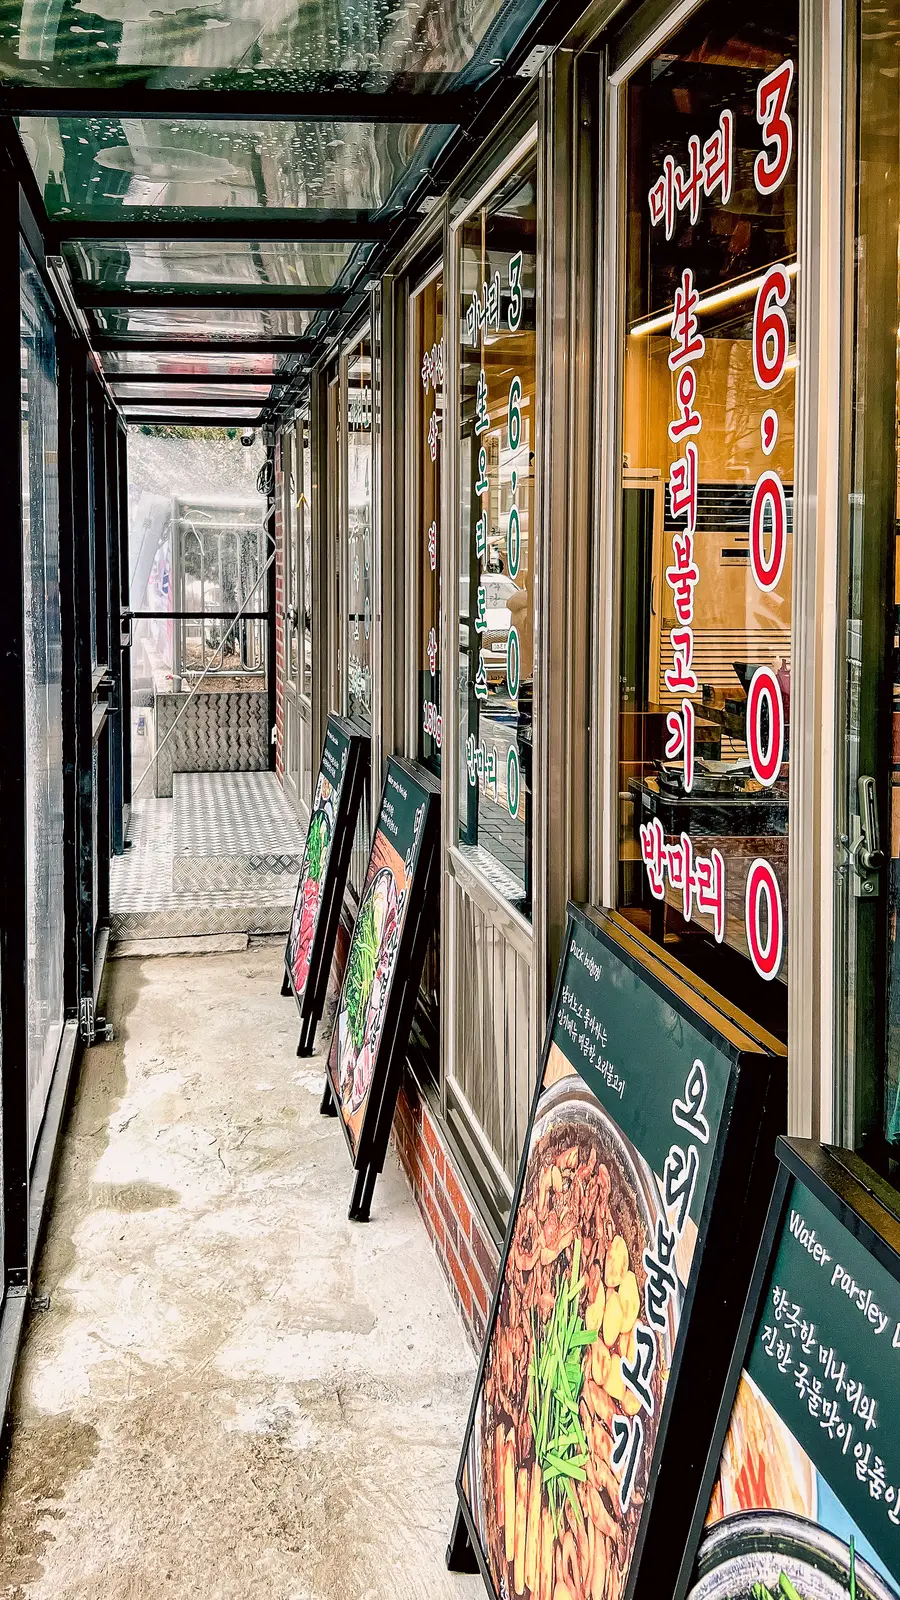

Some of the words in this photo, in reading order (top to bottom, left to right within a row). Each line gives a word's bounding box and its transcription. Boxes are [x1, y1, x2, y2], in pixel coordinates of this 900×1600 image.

[648, 109, 733, 240] 미나리
[466, 270, 500, 348] 미나리
[743, 59, 794, 981] 36,000
[423, 699, 443, 748] 150g
[466, 733, 497, 803] 반마리
[639, 816, 725, 943] 반마리
[570, 939, 584, 964] Duck
[562, 985, 583, 1019] 남녀노소
[558, 1008, 578, 1042] 인기메뉴
[595, 1056, 626, 1099] 오리불고기
[610, 1058, 709, 1513] 오리불고기
[789, 1209, 832, 1267] Water
[831, 1263, 888, 1334] parsley
[761, 1324, 792, 1373] 진한
[794, 1361, 852, 1454] 국물맛이
[818, 1344, 877, 1431] 미나리와
